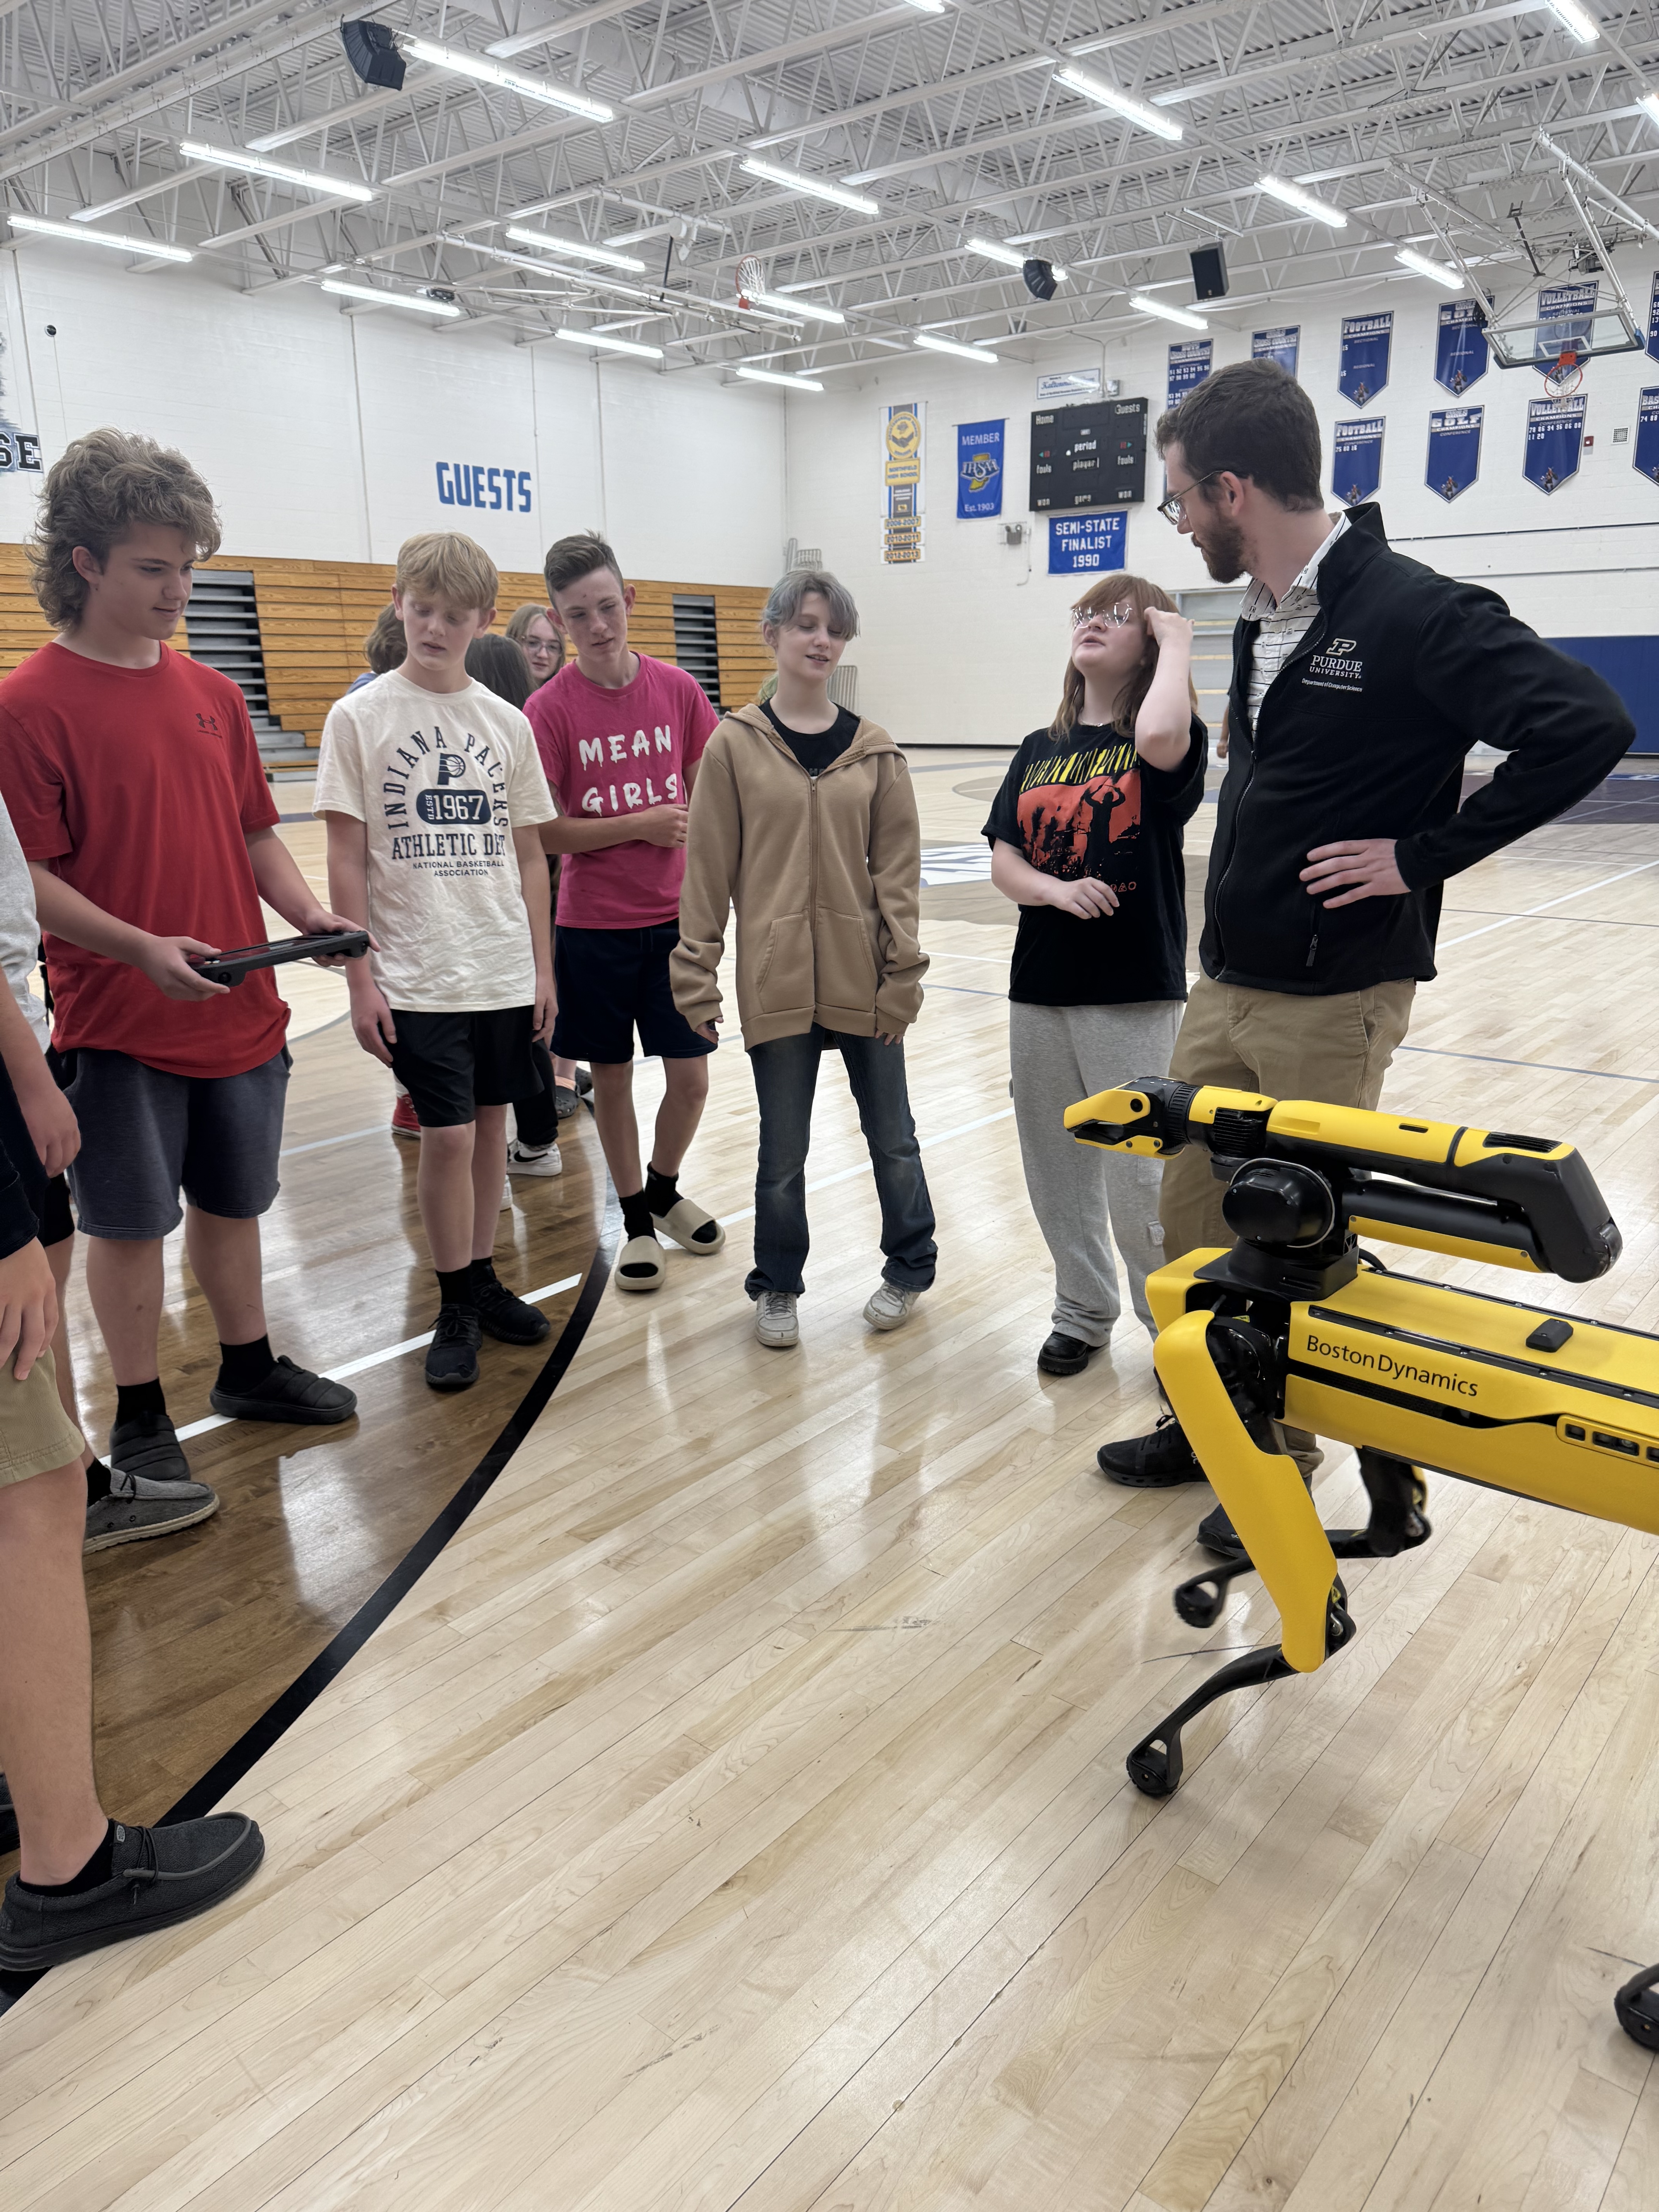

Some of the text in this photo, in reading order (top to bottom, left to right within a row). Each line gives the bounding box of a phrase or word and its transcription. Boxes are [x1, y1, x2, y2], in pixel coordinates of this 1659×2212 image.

[1541, 285, 1595, 305] VOLLEYBALL
[1546, 301, 1587, 310] CHAMPIONS
[1441, 309, 1474, 321] GOL
[1344, 314, 1390, 333] FOOTBALL
[1348, 330, 1385, 338] CHAMPIONS
[1115, 404, 1140, 414] Guests
[1036, 415, 1054, 425] Home
[1432, 412, 1481, 427] GOLF
[1337, 420, 1382, 437] FOOTBALL
[962, 432, 1000, 446] MEMBER
[1074, 440, 1096, 453] period
[1118, 455, 1133, 465] fouls
[1036, 464, 1052, 474] fouls
[436, 461, 531, 512] GUESTS
[977, 502, 995, 511] 1903
[1056, 517, 1120, 535] SEMI-STATE
[1061, 535, 1111, 551] FINALIST
[1073, 554, 1099, 568] 1990
[1310, 655, 1363, 672] PURDUE
[579, 725, 671, 771] MEAN
[383, 726, 508, 830] INDIANA PACERS
[582, 773, 677, 817] GIRLS
[425, 794, 434, 820] ESTD
[433, 795, 483, 820] 1967
[391, 833, 477, 859] ATHLETIC
[413, 861, 454, 869] NATIONAL
[1307, 1335, 1478, 1397] Boston Dynamics
